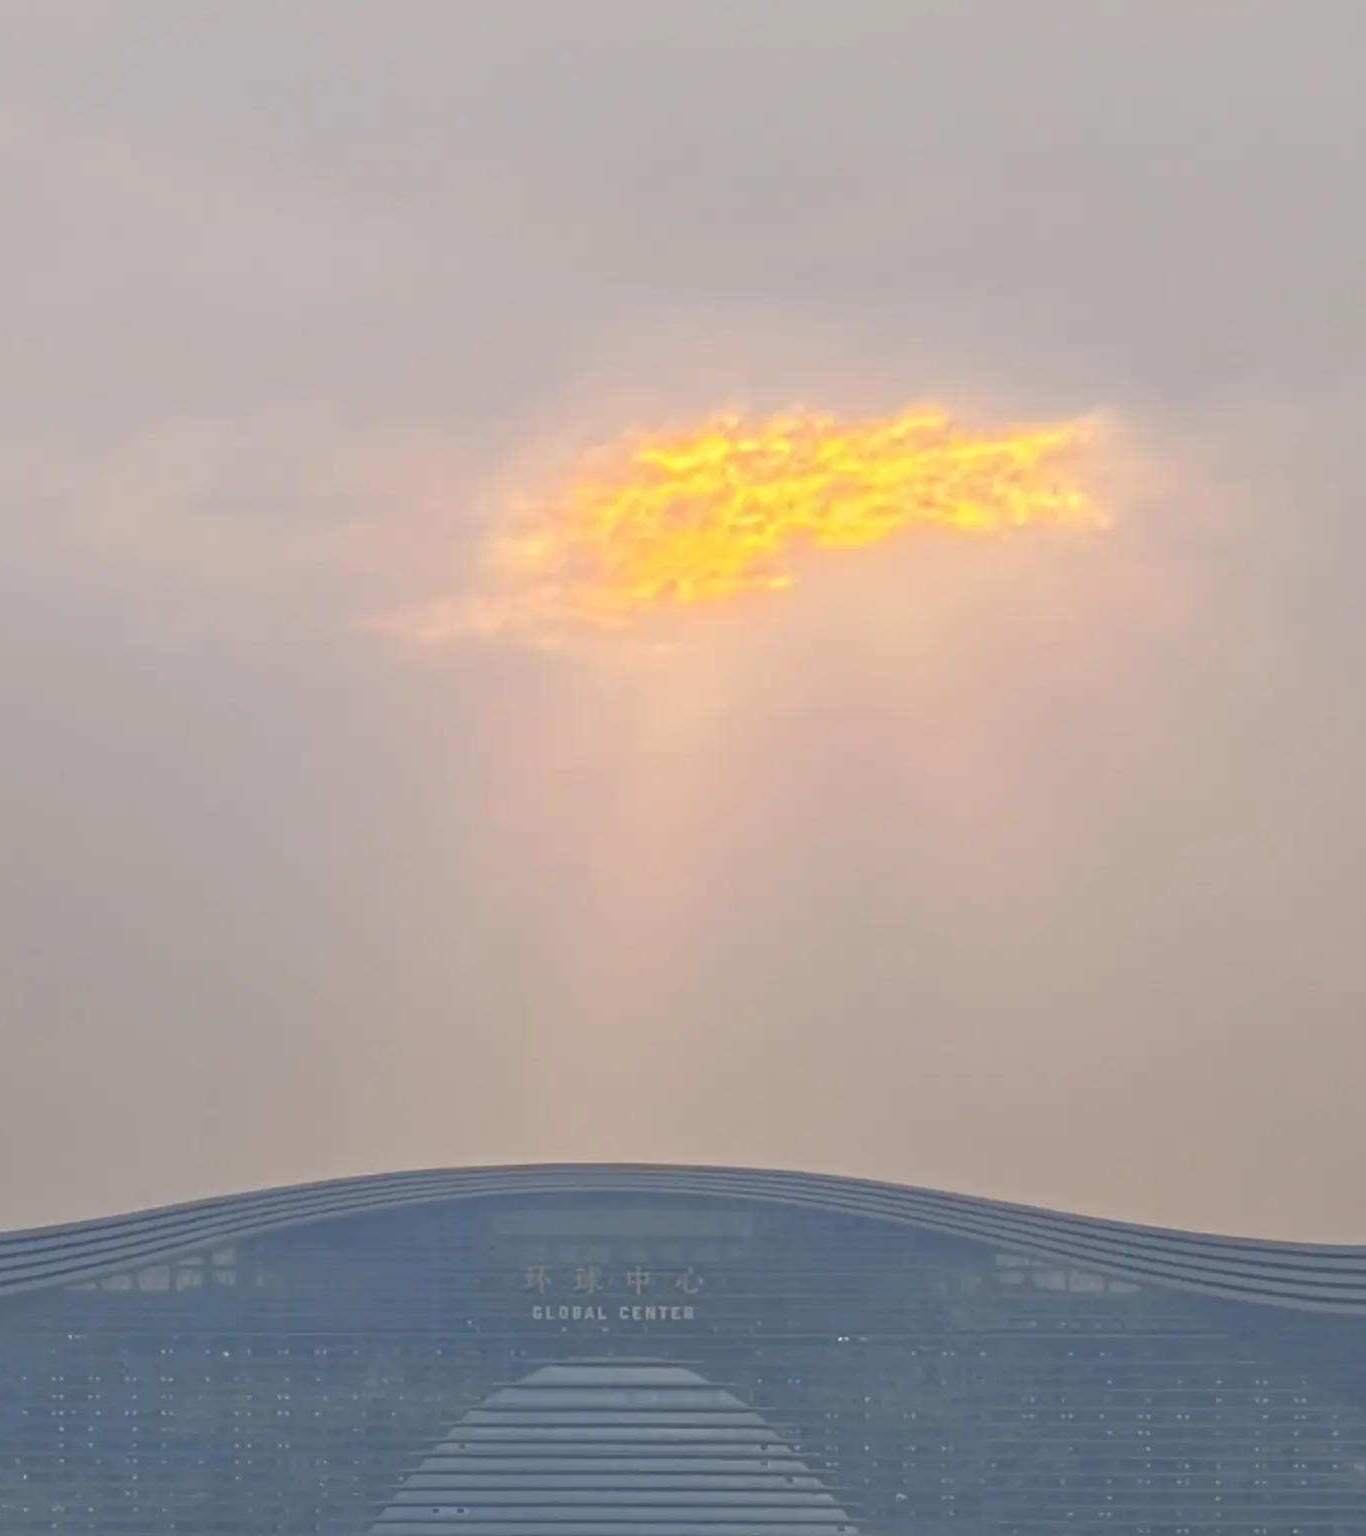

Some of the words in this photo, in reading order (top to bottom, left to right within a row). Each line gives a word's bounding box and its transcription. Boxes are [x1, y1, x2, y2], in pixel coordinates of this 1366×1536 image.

[524, 1265, 704, 1295] 环球中心
[532, 1305, 608, 1320] GLOBAL
[619, 1305, 695, 1320] CENTER
